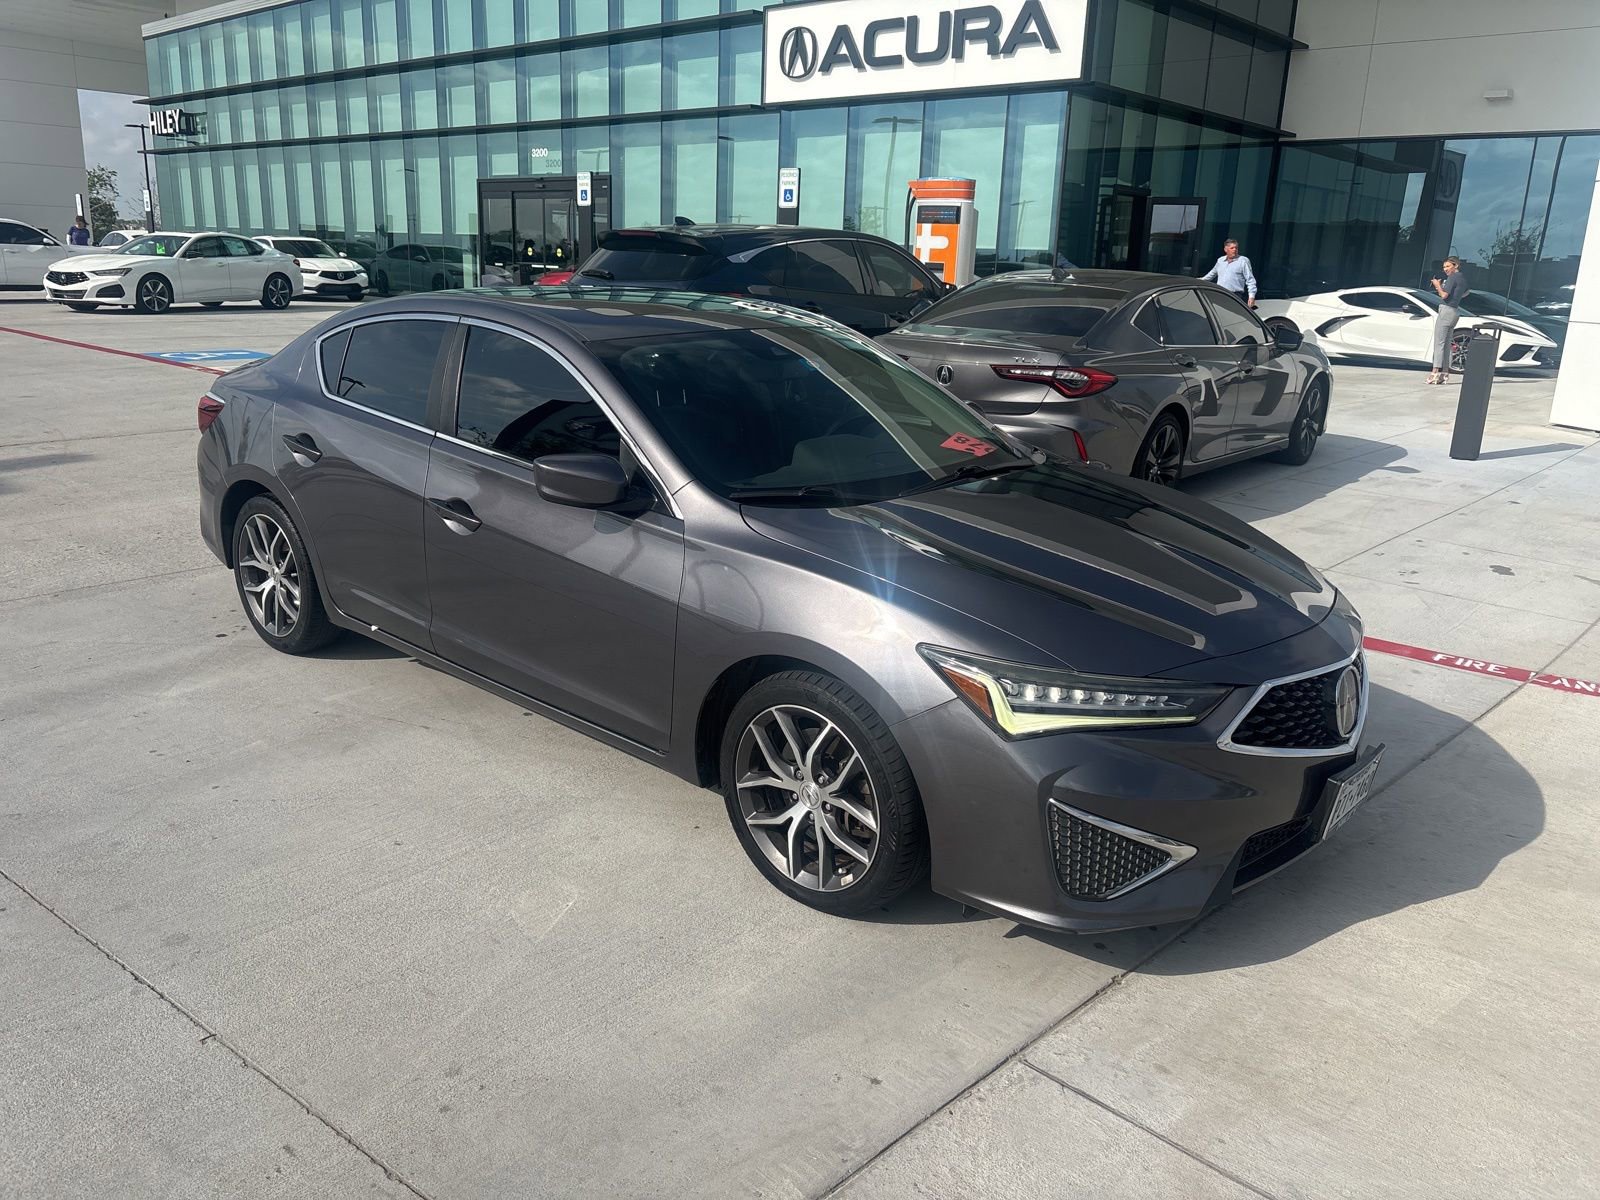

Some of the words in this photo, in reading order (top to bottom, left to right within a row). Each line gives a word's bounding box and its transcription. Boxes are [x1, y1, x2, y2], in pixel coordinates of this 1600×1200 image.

[817, 0, 1062, 73] ACURA
[148, 108, 180, 136] HILEY
[531, 148, 548, 158] 3200
[1012, 356, 1042, 365] TLX
[1433, 653, 1508, 675] FIRE
[1527, 671, 1600, 693] LAN
